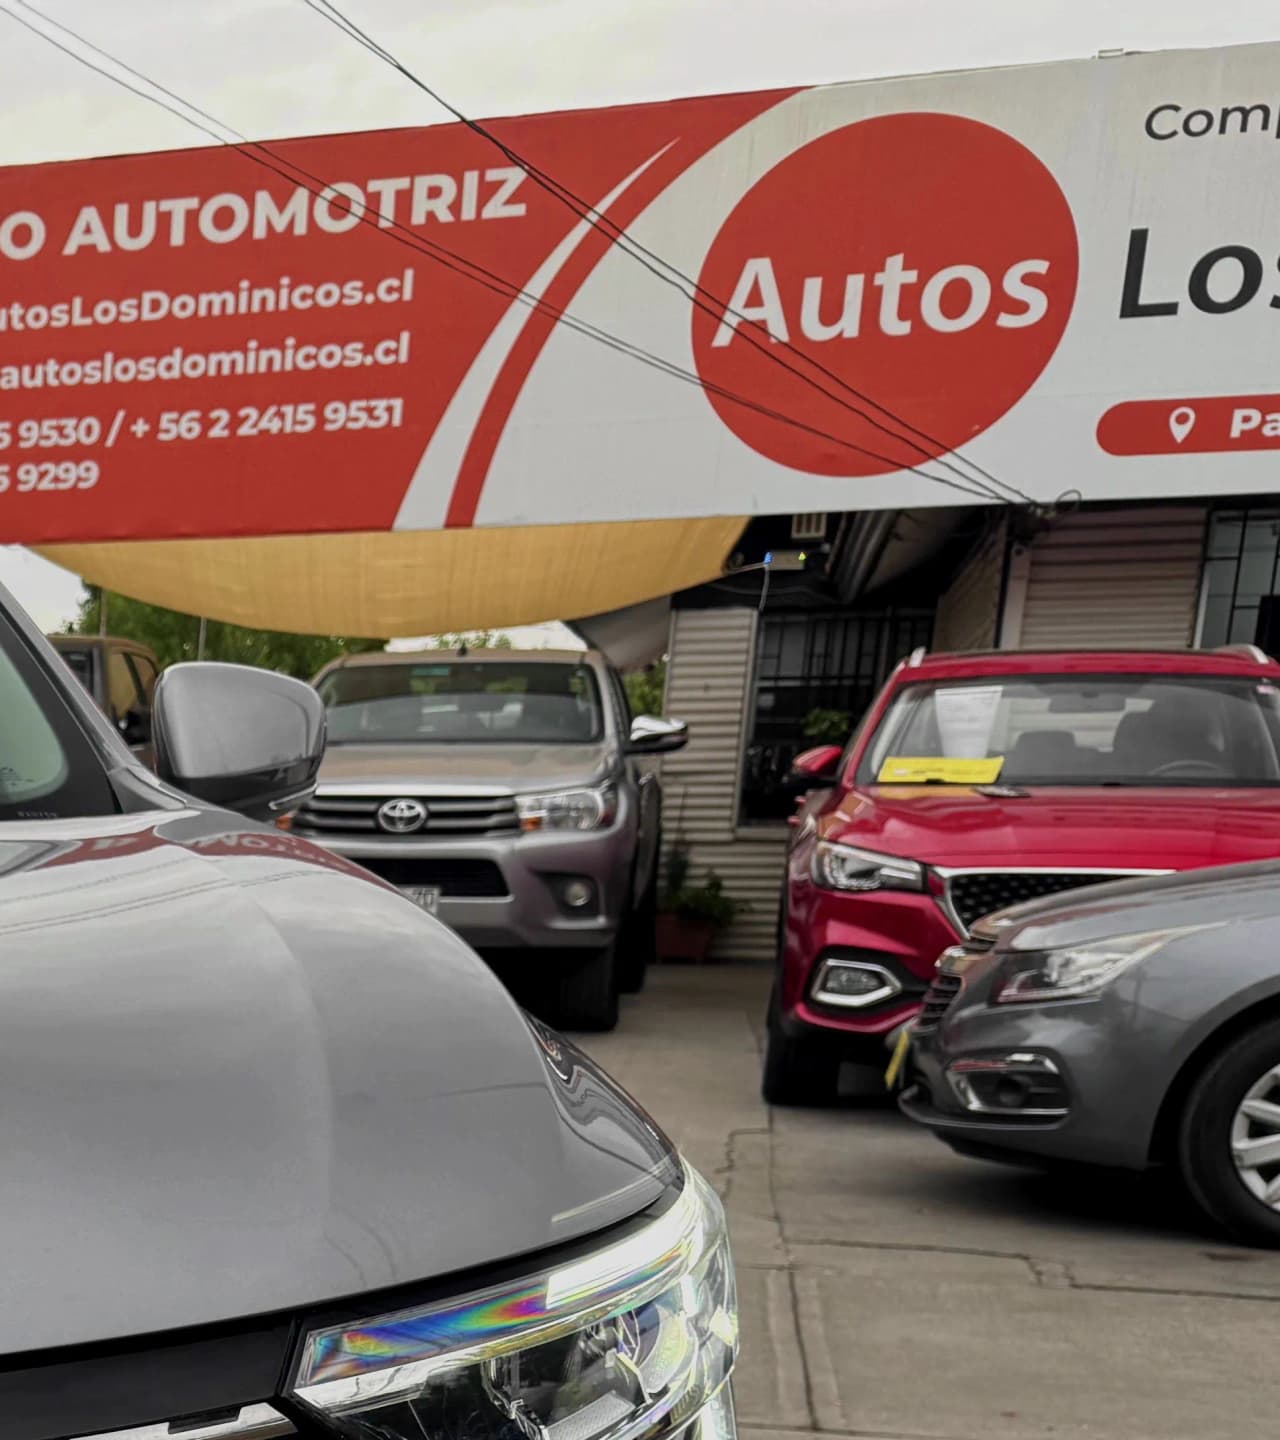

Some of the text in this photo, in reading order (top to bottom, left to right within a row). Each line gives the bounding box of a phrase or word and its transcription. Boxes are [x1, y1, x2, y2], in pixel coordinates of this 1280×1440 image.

[1144, 102, 1280, 141] Com
[62, 165, 529, 256] AUTOMOTRIZ
[711, 252, 1050, 348] Autos
[1118, 227, 1280, 319] Lo
[17, 416, 101, 448] 9530
[156, 411, 202, 441] 56
[208, 409, 231, 438] 2
[236, 403, 316, 436] 2415
[323, 397, 404, 432] 9531
[16, 460, 100, 492] 9299
